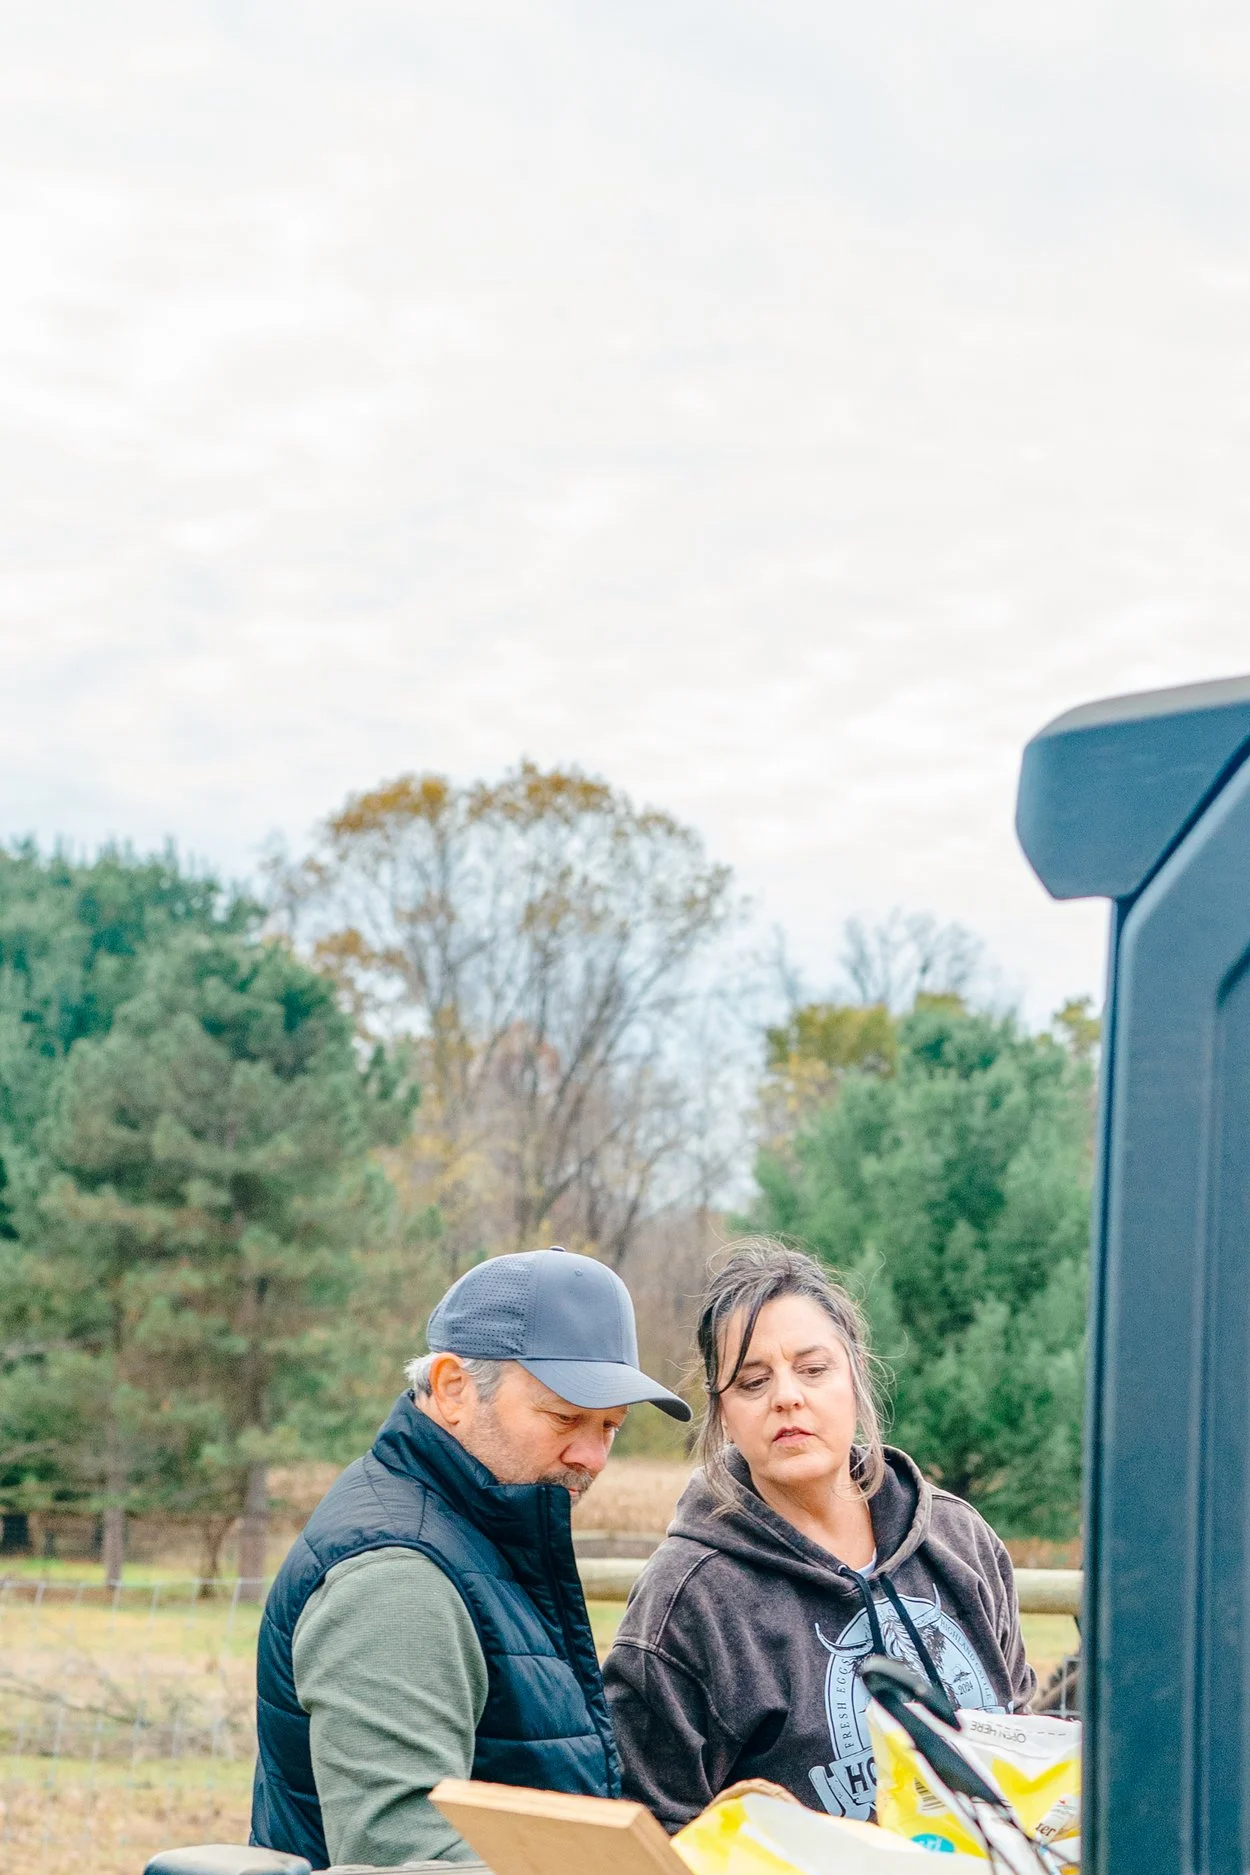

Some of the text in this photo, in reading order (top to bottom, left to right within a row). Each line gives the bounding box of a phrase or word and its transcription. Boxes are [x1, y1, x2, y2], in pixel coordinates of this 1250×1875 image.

[957, 1681, 975, 1696] 2024
[836, 1657, 855, 1750] FRESH EGGS
[969, 1720, 998, 1739] HERE
